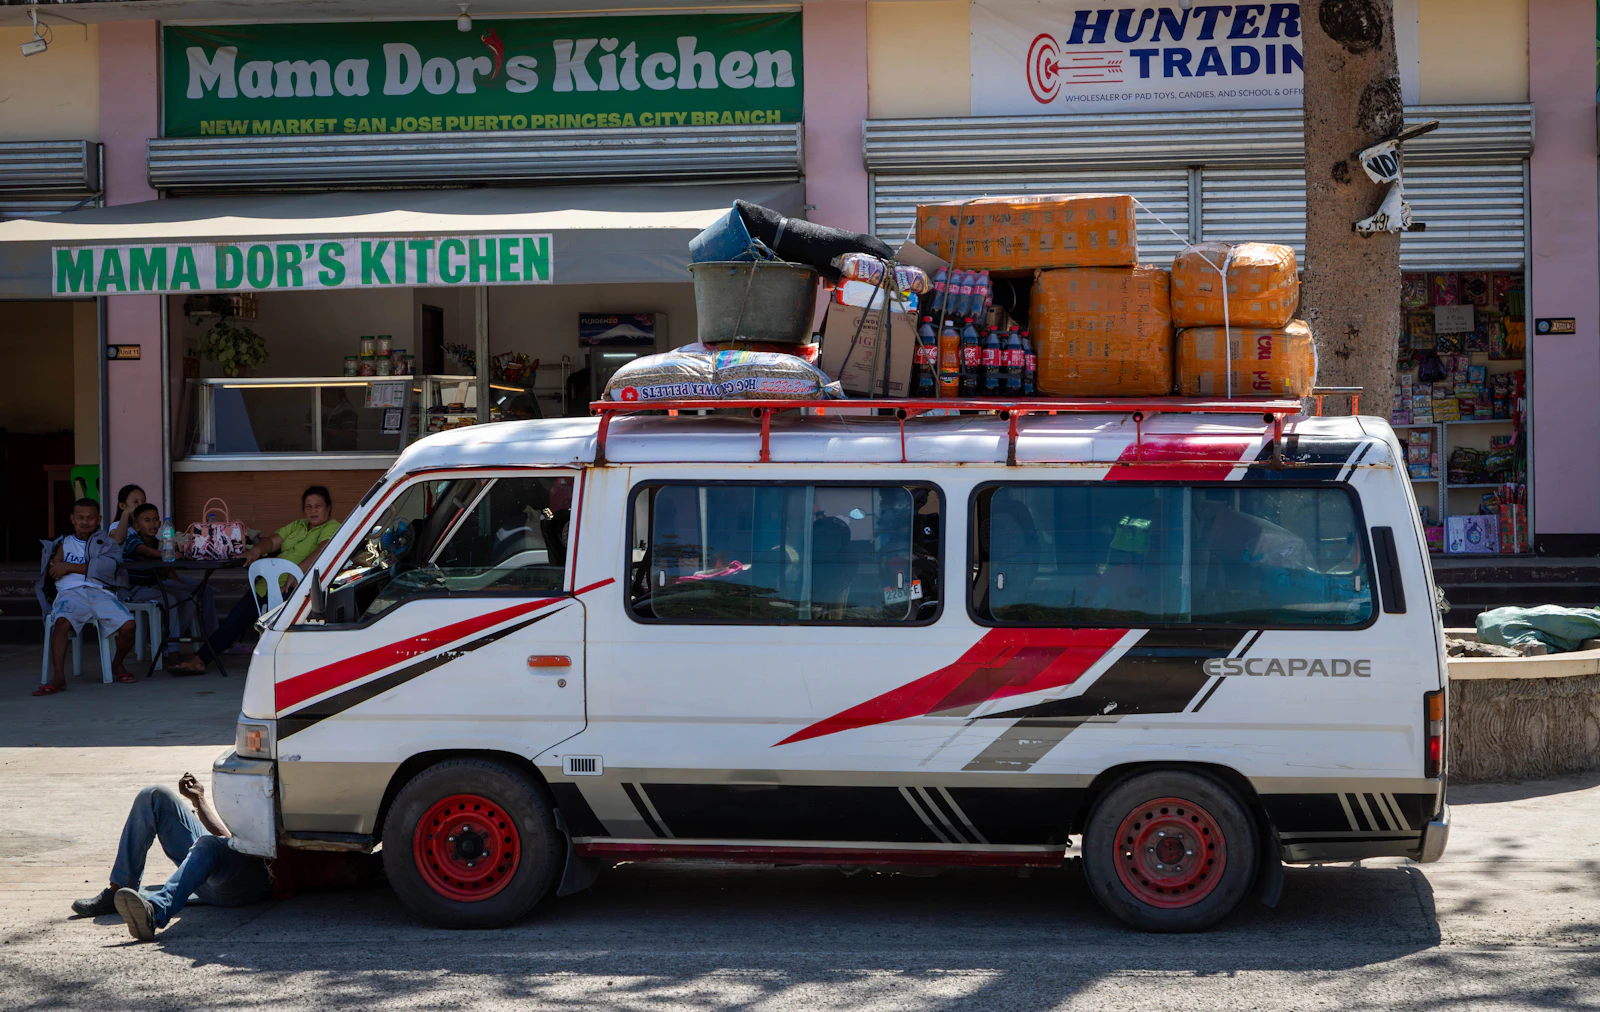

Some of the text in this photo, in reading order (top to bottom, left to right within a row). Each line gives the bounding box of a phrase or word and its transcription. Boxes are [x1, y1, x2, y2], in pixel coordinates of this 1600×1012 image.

[1066, 3, 1301, 44] HUNTER
[186, 45, 370, 99] Mama
[553, 36, 796, 93] Kitchen
[1065, 93, 1120, 102] WHOLESALER
[1121, 92, 1132, 101] OF
[1135, 92, 1151, 100] PAD
[1154, 91, 1177, 100] TOYS,
[1178, 90, 1216, 99] CANDIES,
[1217, 90, 1236, 98] AND
[1238, 88, 1272, 97] SCHOOL
[1274, 88, 1280, 96] &
[200, 110, 781, 135] NEW MARKET SAN JOSE PUERTO PRINCESA CITY BRANCH
[56, 236, 549, 293] MAMA DOR'S KITCHEN
[642, 384, 688, 399] PELLETS
[736, 379, 757, 391] HOG
[1203, 658, 1371, 677] ESCAPADE
